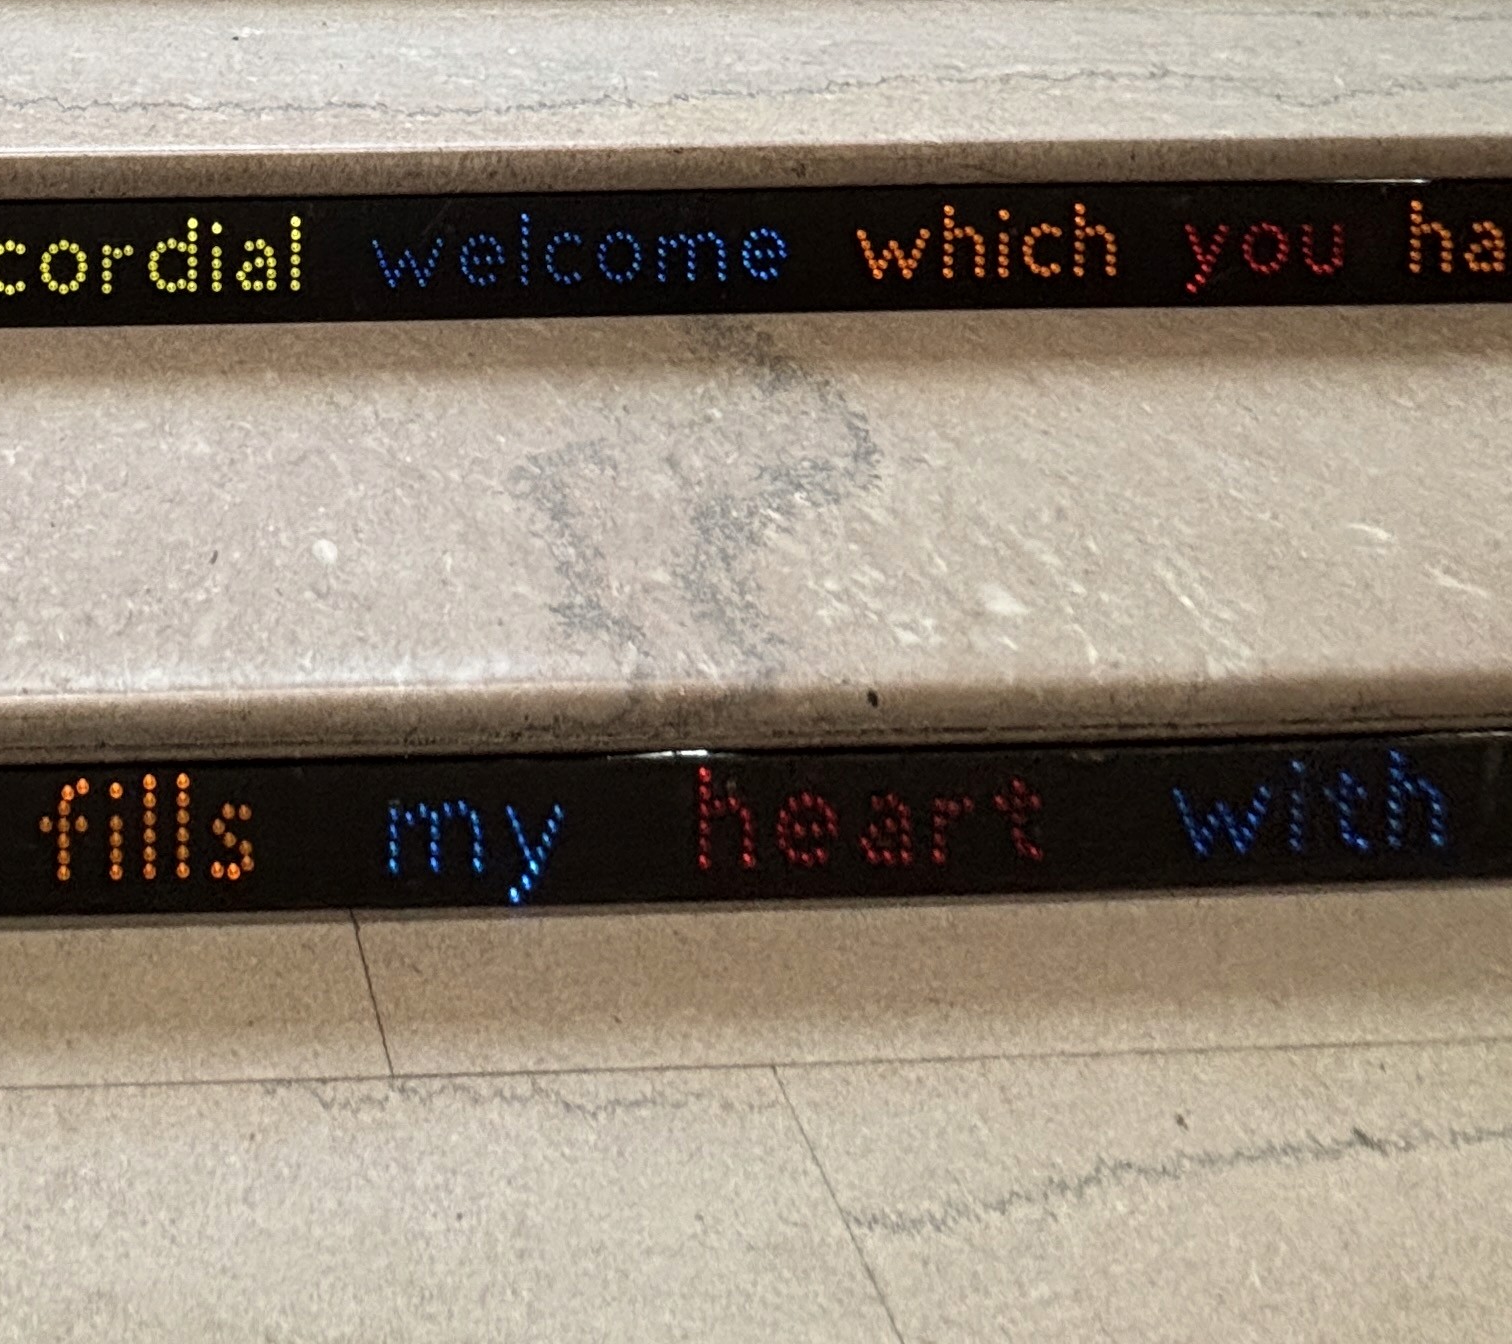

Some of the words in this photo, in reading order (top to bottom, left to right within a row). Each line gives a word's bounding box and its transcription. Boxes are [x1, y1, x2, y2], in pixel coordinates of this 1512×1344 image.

[371, 212, 788, 288] welcome
[855, 202, 1118, 281] which
[1184, 221, 1346, 291] you
[39, 772, 254, 882] fills
[387, 799, 564, 905] my
[697, 766, 1045, 870] heart
[1172, 749, 1450, 859] with
